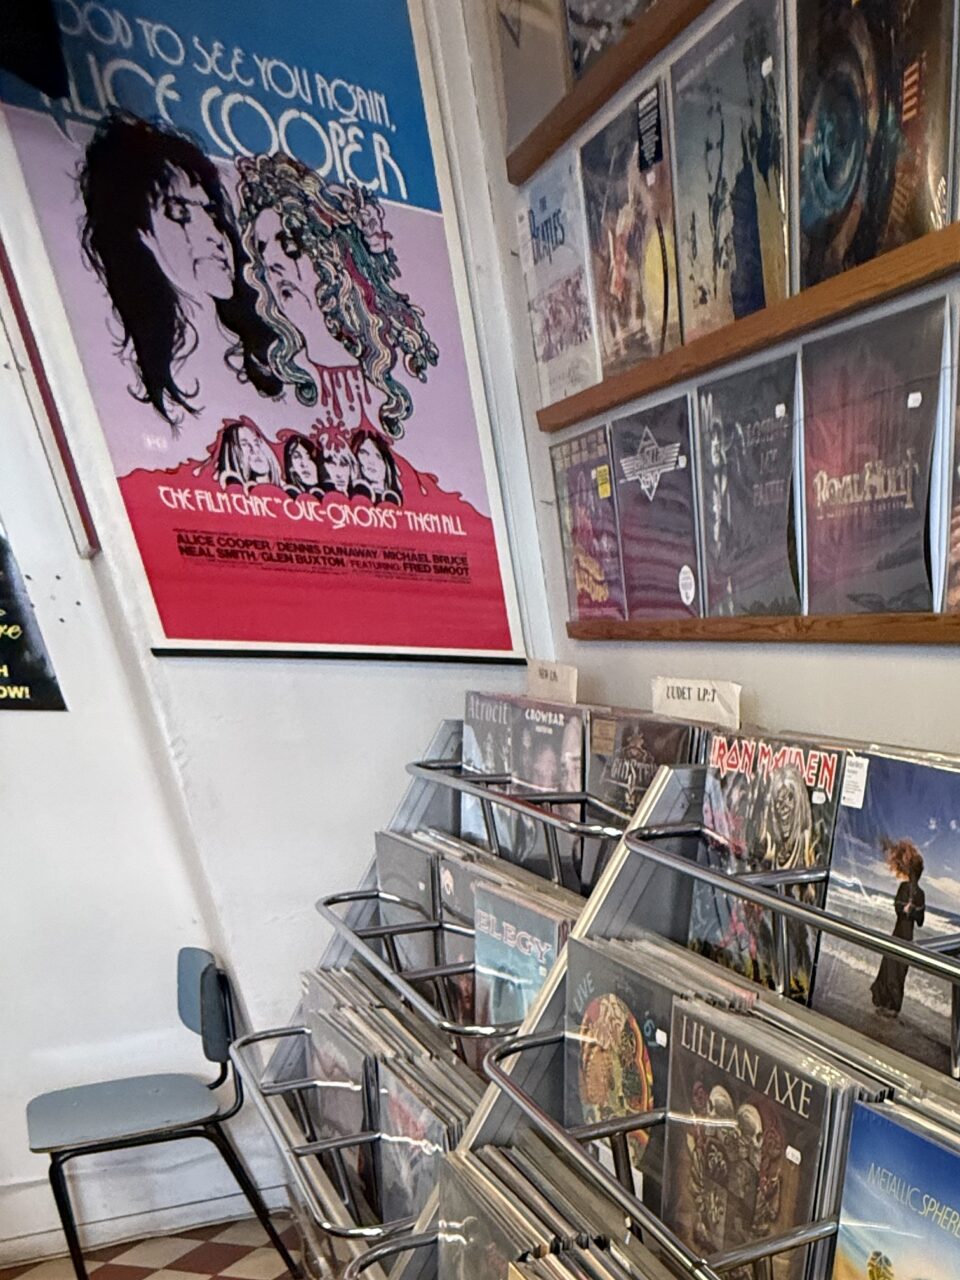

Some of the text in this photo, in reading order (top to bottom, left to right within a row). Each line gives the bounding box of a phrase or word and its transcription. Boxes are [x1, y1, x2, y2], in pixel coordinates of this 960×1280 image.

[57, 0, 132, 48] OOD
[136, 18, 185, 65] TO
[193, 36, 254, 86] SEE
[254, 55, 312, 104] YOU
[38, 52, 407, 199] LICE COOPER
[158, 486, 194, 511] THE
[195, 489, 234, 512] FILM
[233, 493, 277, 517] THAT
[404, 511, 442, 533] THEM
[441, 515, 467, 536] ALL
[177, 533, 215, 546] ALICE
[216, 536, 271, 550] COOPER
[276, 541, 321, 555] DENNIS
[322, 545, 378, 559] DUNAWAY
[383, 550, 431, 563] MICHAEL
[432, 554, 467, 566] BRUCE
[178, 545, 215, 557] NEAL
[216, 548, 256, 560] SMITH
[261, 551, 294, 563] GLEN
[296, 555, 345, 567] BUXTON
[403, 562, 432, 573] FRED
[433, 564, 469, 577] SMOOT
[524, 707, 566, 727] CROWBAR
[710, 735, 755, 785] IRON
[757, 742, 838, 802] MAIDEN
[474, 908, 553, 965] ELEGY
[681, 1014, 760, 1088] LILLIAN
[763, 1065, 813, 1120] AXE
[867, 1162, 921, 1214] METALLIC
